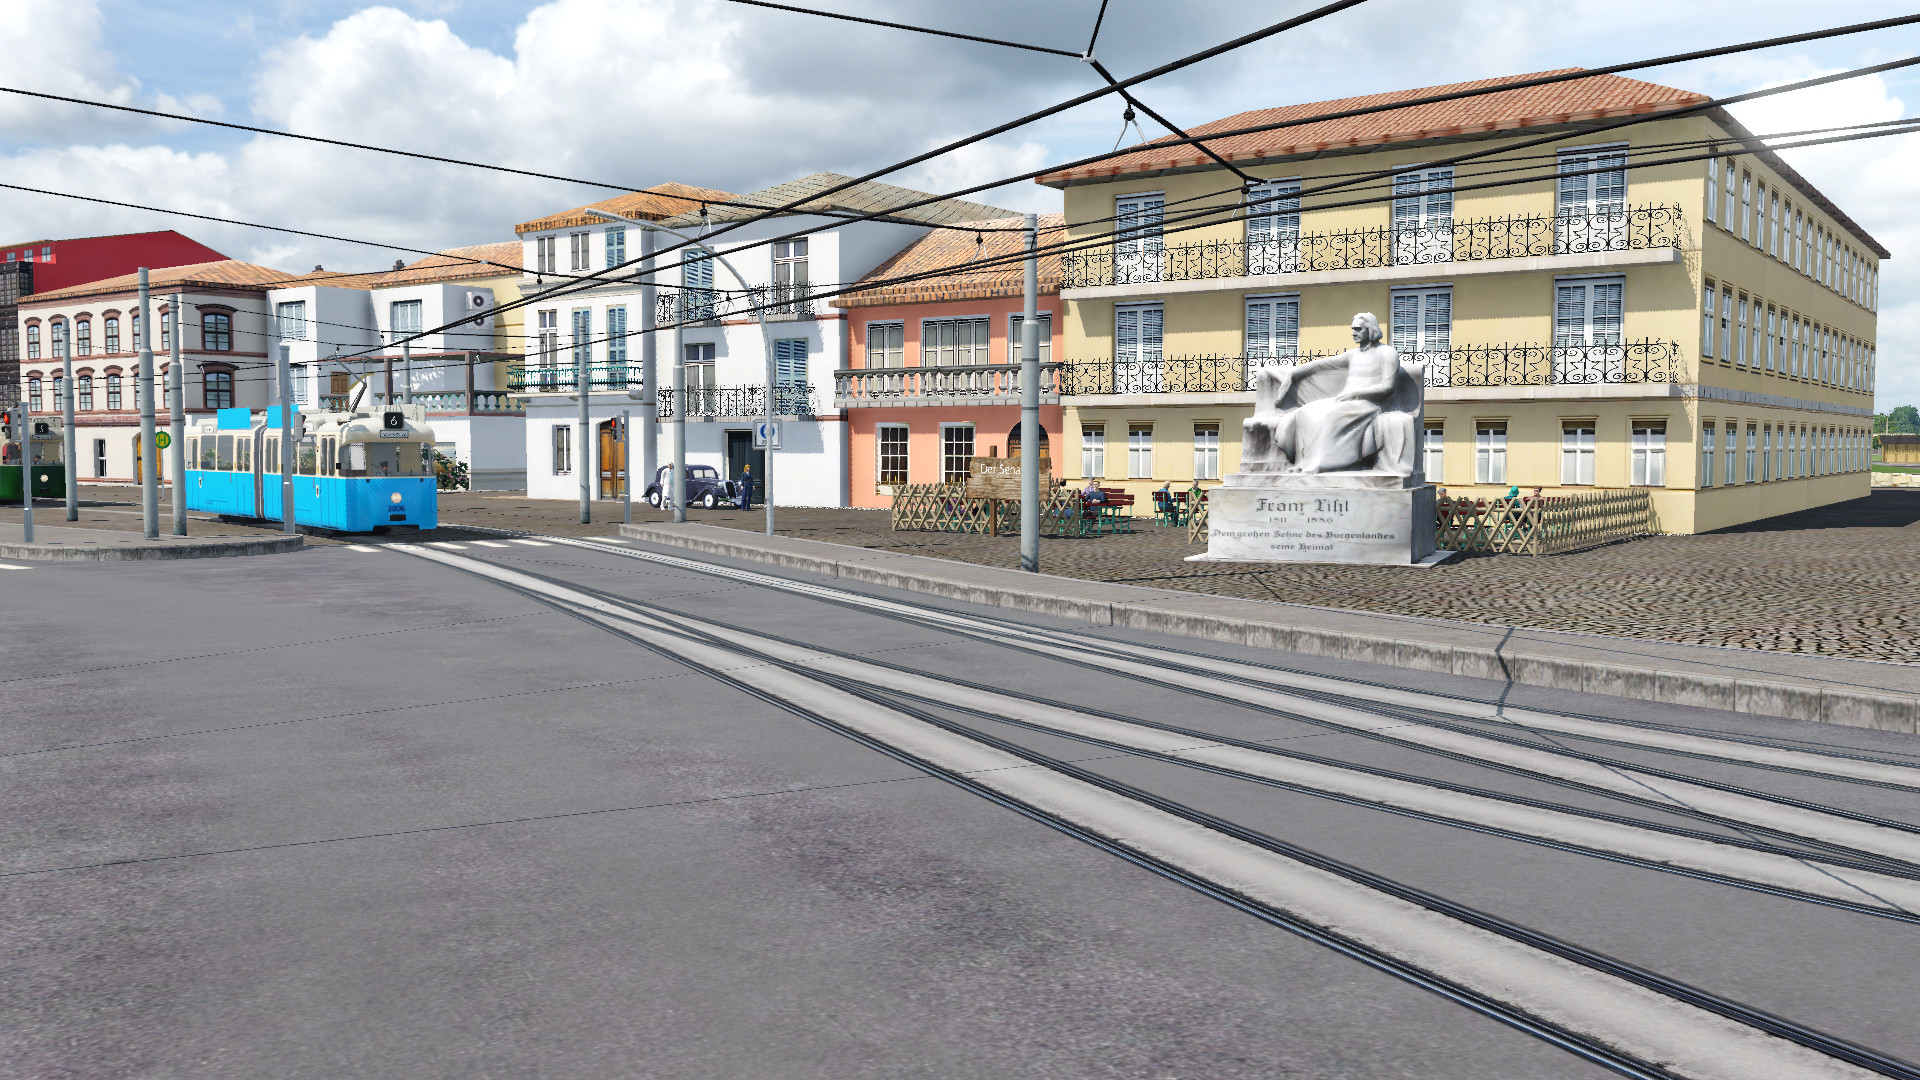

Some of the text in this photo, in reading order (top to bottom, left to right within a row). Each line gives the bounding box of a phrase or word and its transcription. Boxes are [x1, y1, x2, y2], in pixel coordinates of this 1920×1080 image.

[390, 416, 398, 426] 6
[158, 435, 167, 445] H
[980, 463, 1021, 475] Der Sena
[1256, 498, 1304, 516] Franz
[1211, 529, 1236, 538] Dem
[1273, 530, 1303, 539] Sohne
[1324, 531, 1395, 541] Burgenlandes
[1298, 543, 1333, 552] Heimat
